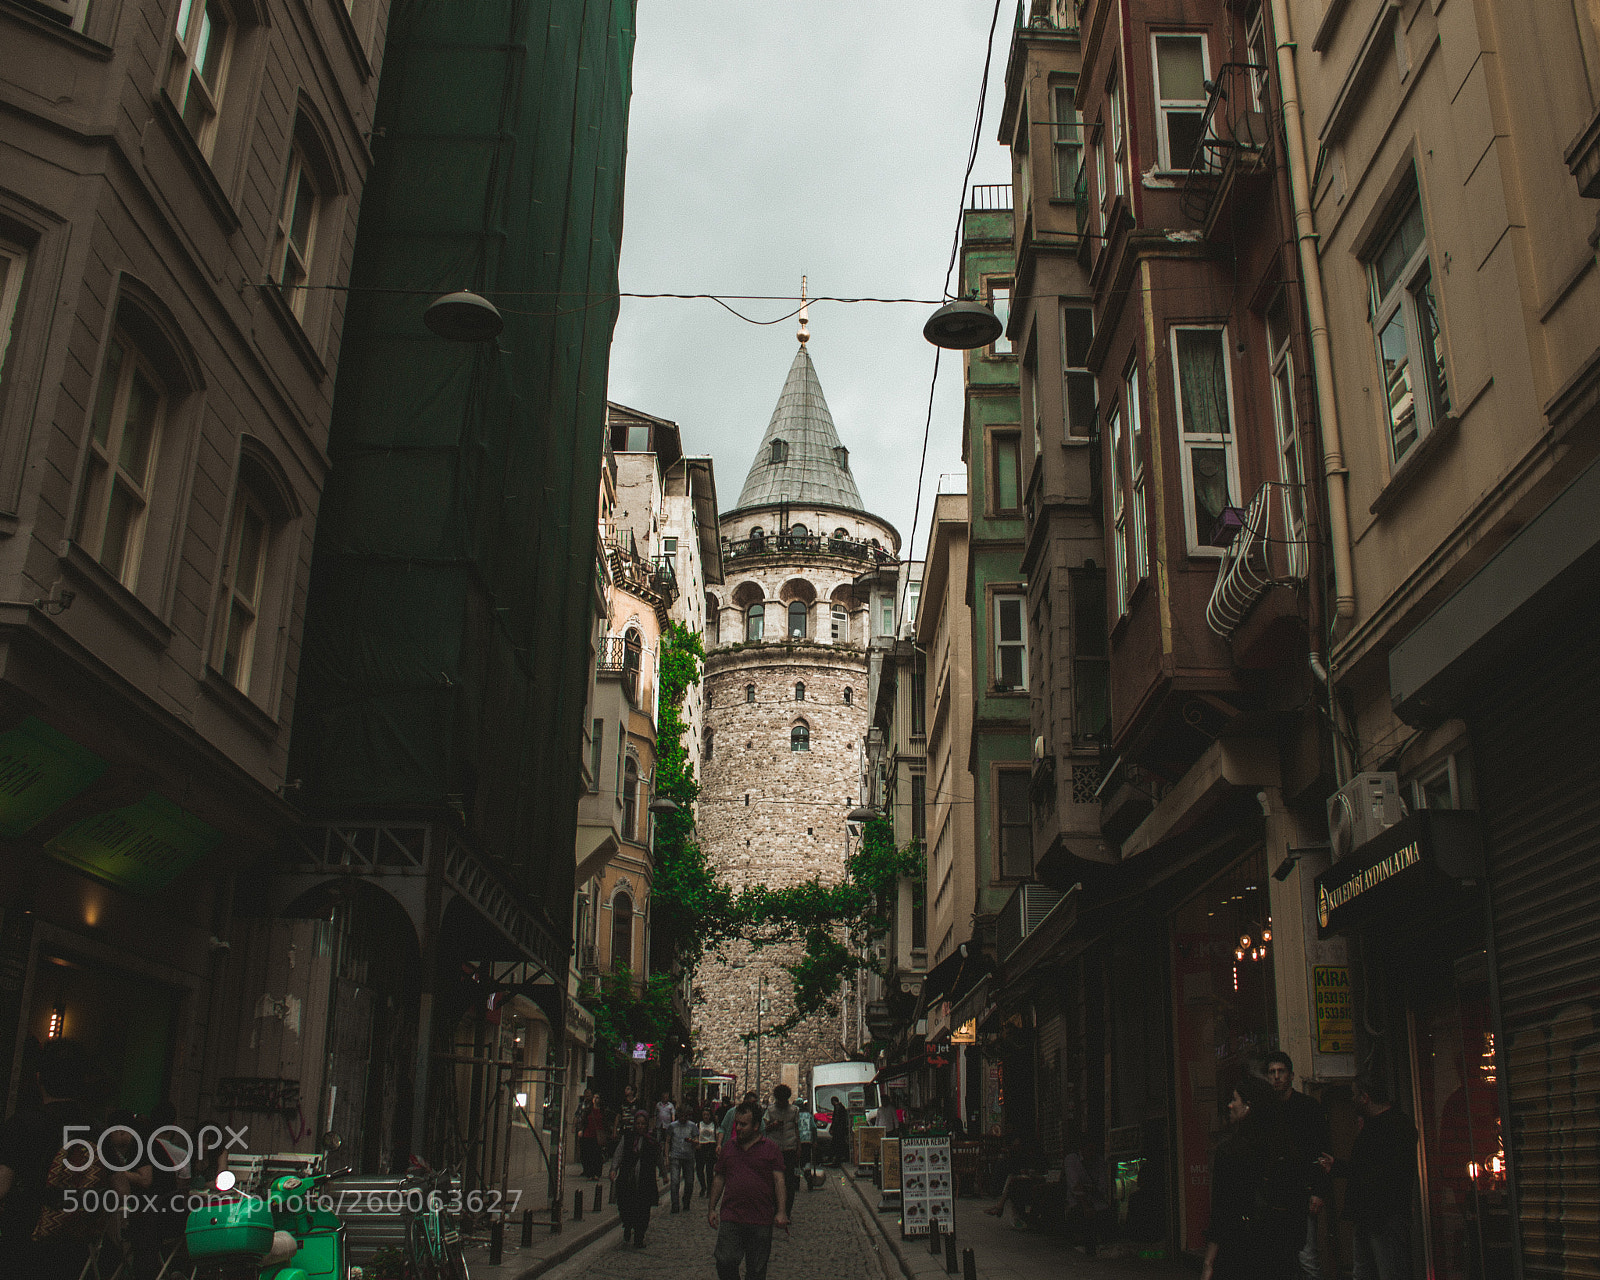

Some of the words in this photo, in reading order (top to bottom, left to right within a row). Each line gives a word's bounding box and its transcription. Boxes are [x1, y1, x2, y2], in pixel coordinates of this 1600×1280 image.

[1329, 869, 1364, 911] KULEDİBİ
[1364, 841, 1421, 891] AYDINLATMA
[1324, 992, 1338, 1004] 533
[1325, 1007, 1339, 1019] 533
[930, 1137, 949, 1146] KEBAP
